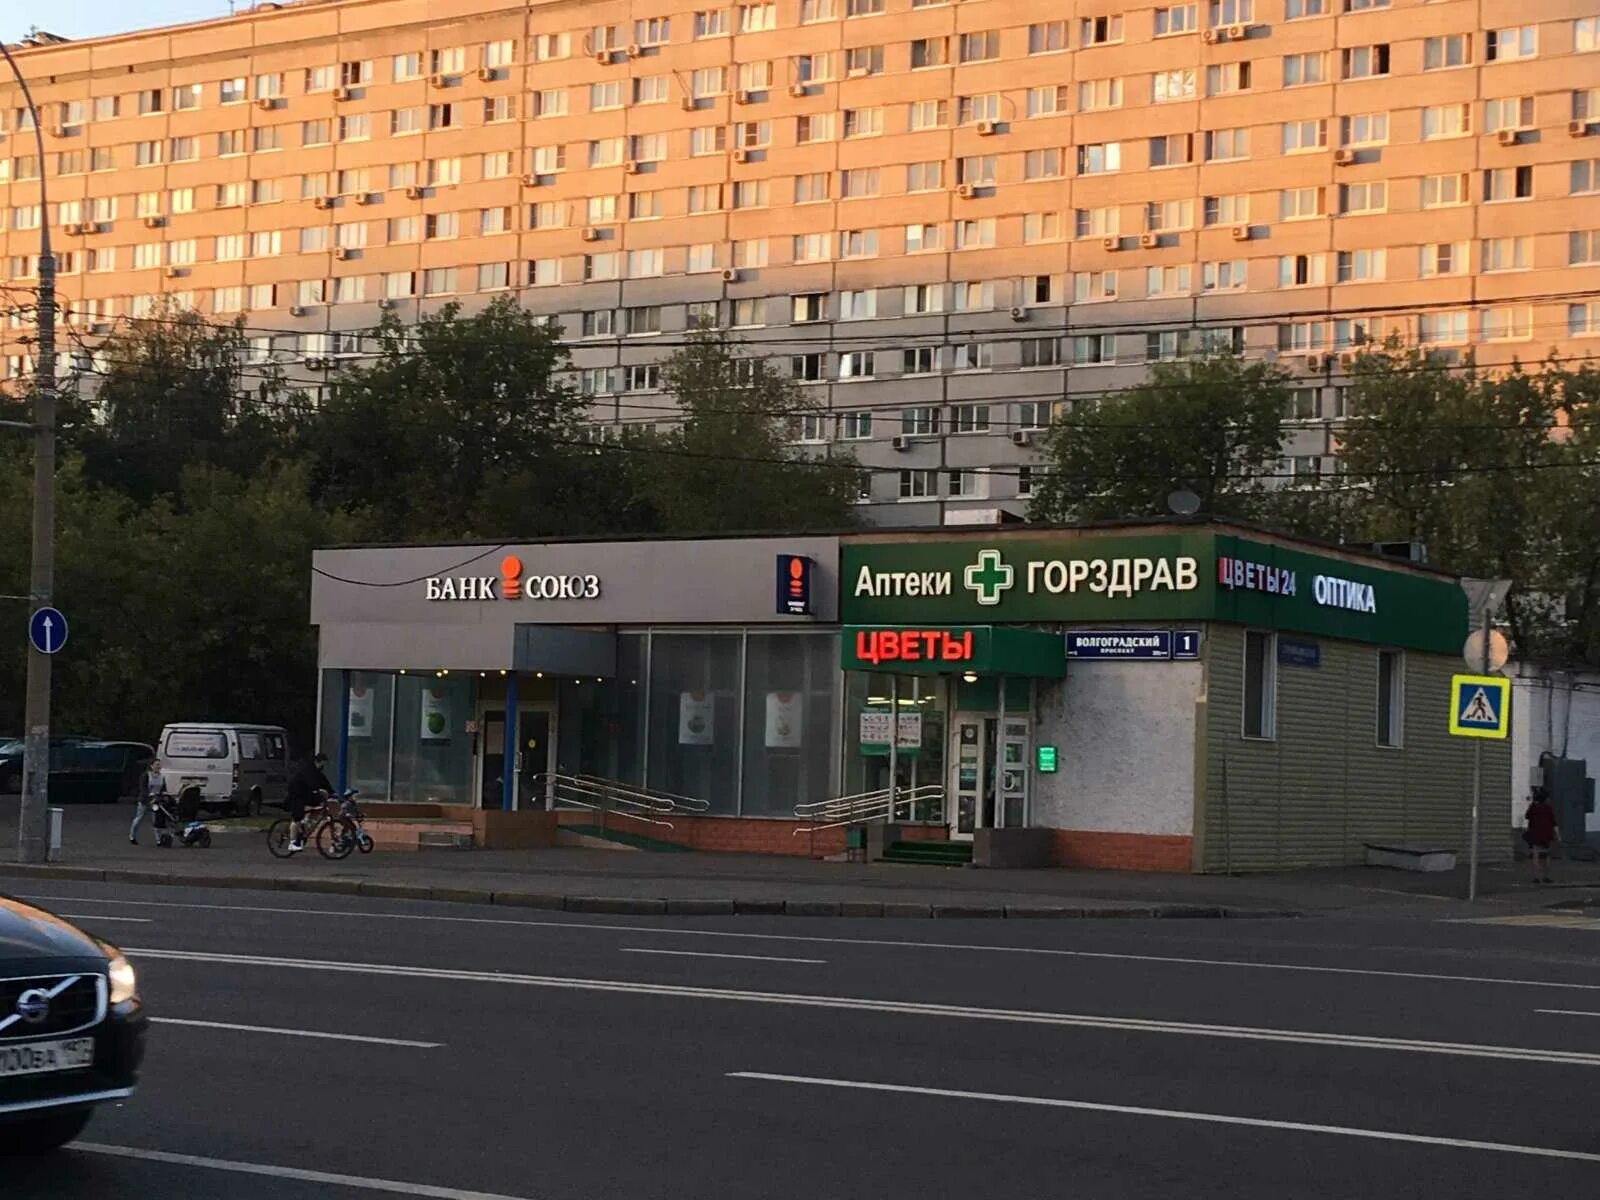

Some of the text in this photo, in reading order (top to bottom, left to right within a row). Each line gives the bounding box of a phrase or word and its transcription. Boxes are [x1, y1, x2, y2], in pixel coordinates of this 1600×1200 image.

[425, 574, 600, 600] БАНК СОЮЗ
[854, 557, 1199, 599] Аптеки ГОРЗДРАВ
[1313, 574, 1377, 614] ОПТИКА
[855, 630, 973, 665] ЦВЕТЫ
[1076, 636, 1160, 648] ВОЛГОГРАДСКИЙ
[1183, 635, 1191, 650] 1
